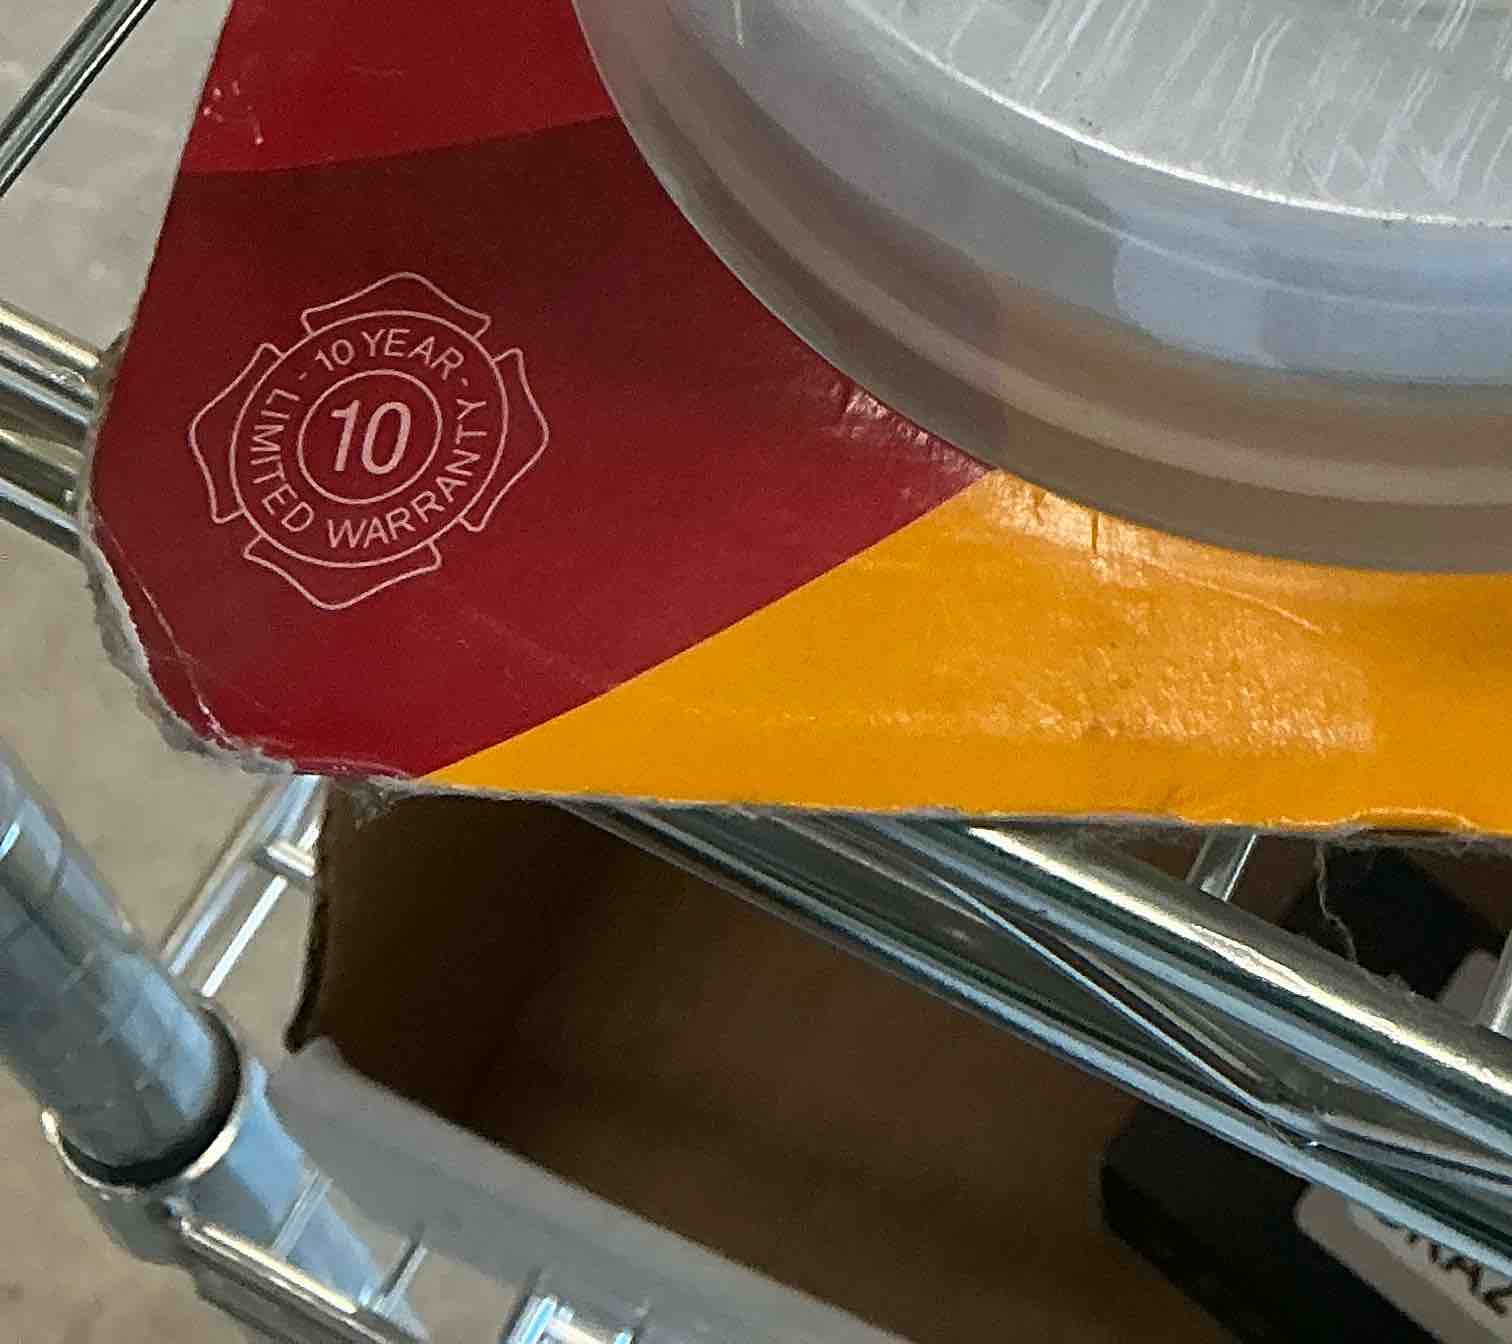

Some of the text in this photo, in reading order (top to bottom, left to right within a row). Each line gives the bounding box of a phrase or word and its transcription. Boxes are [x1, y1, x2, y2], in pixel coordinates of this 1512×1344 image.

[314, 328, 464, 381] 10 YEAR
[249, 388, 489, 550] LIMITED WARRANTY
[331, 399, 412, 476] 10
